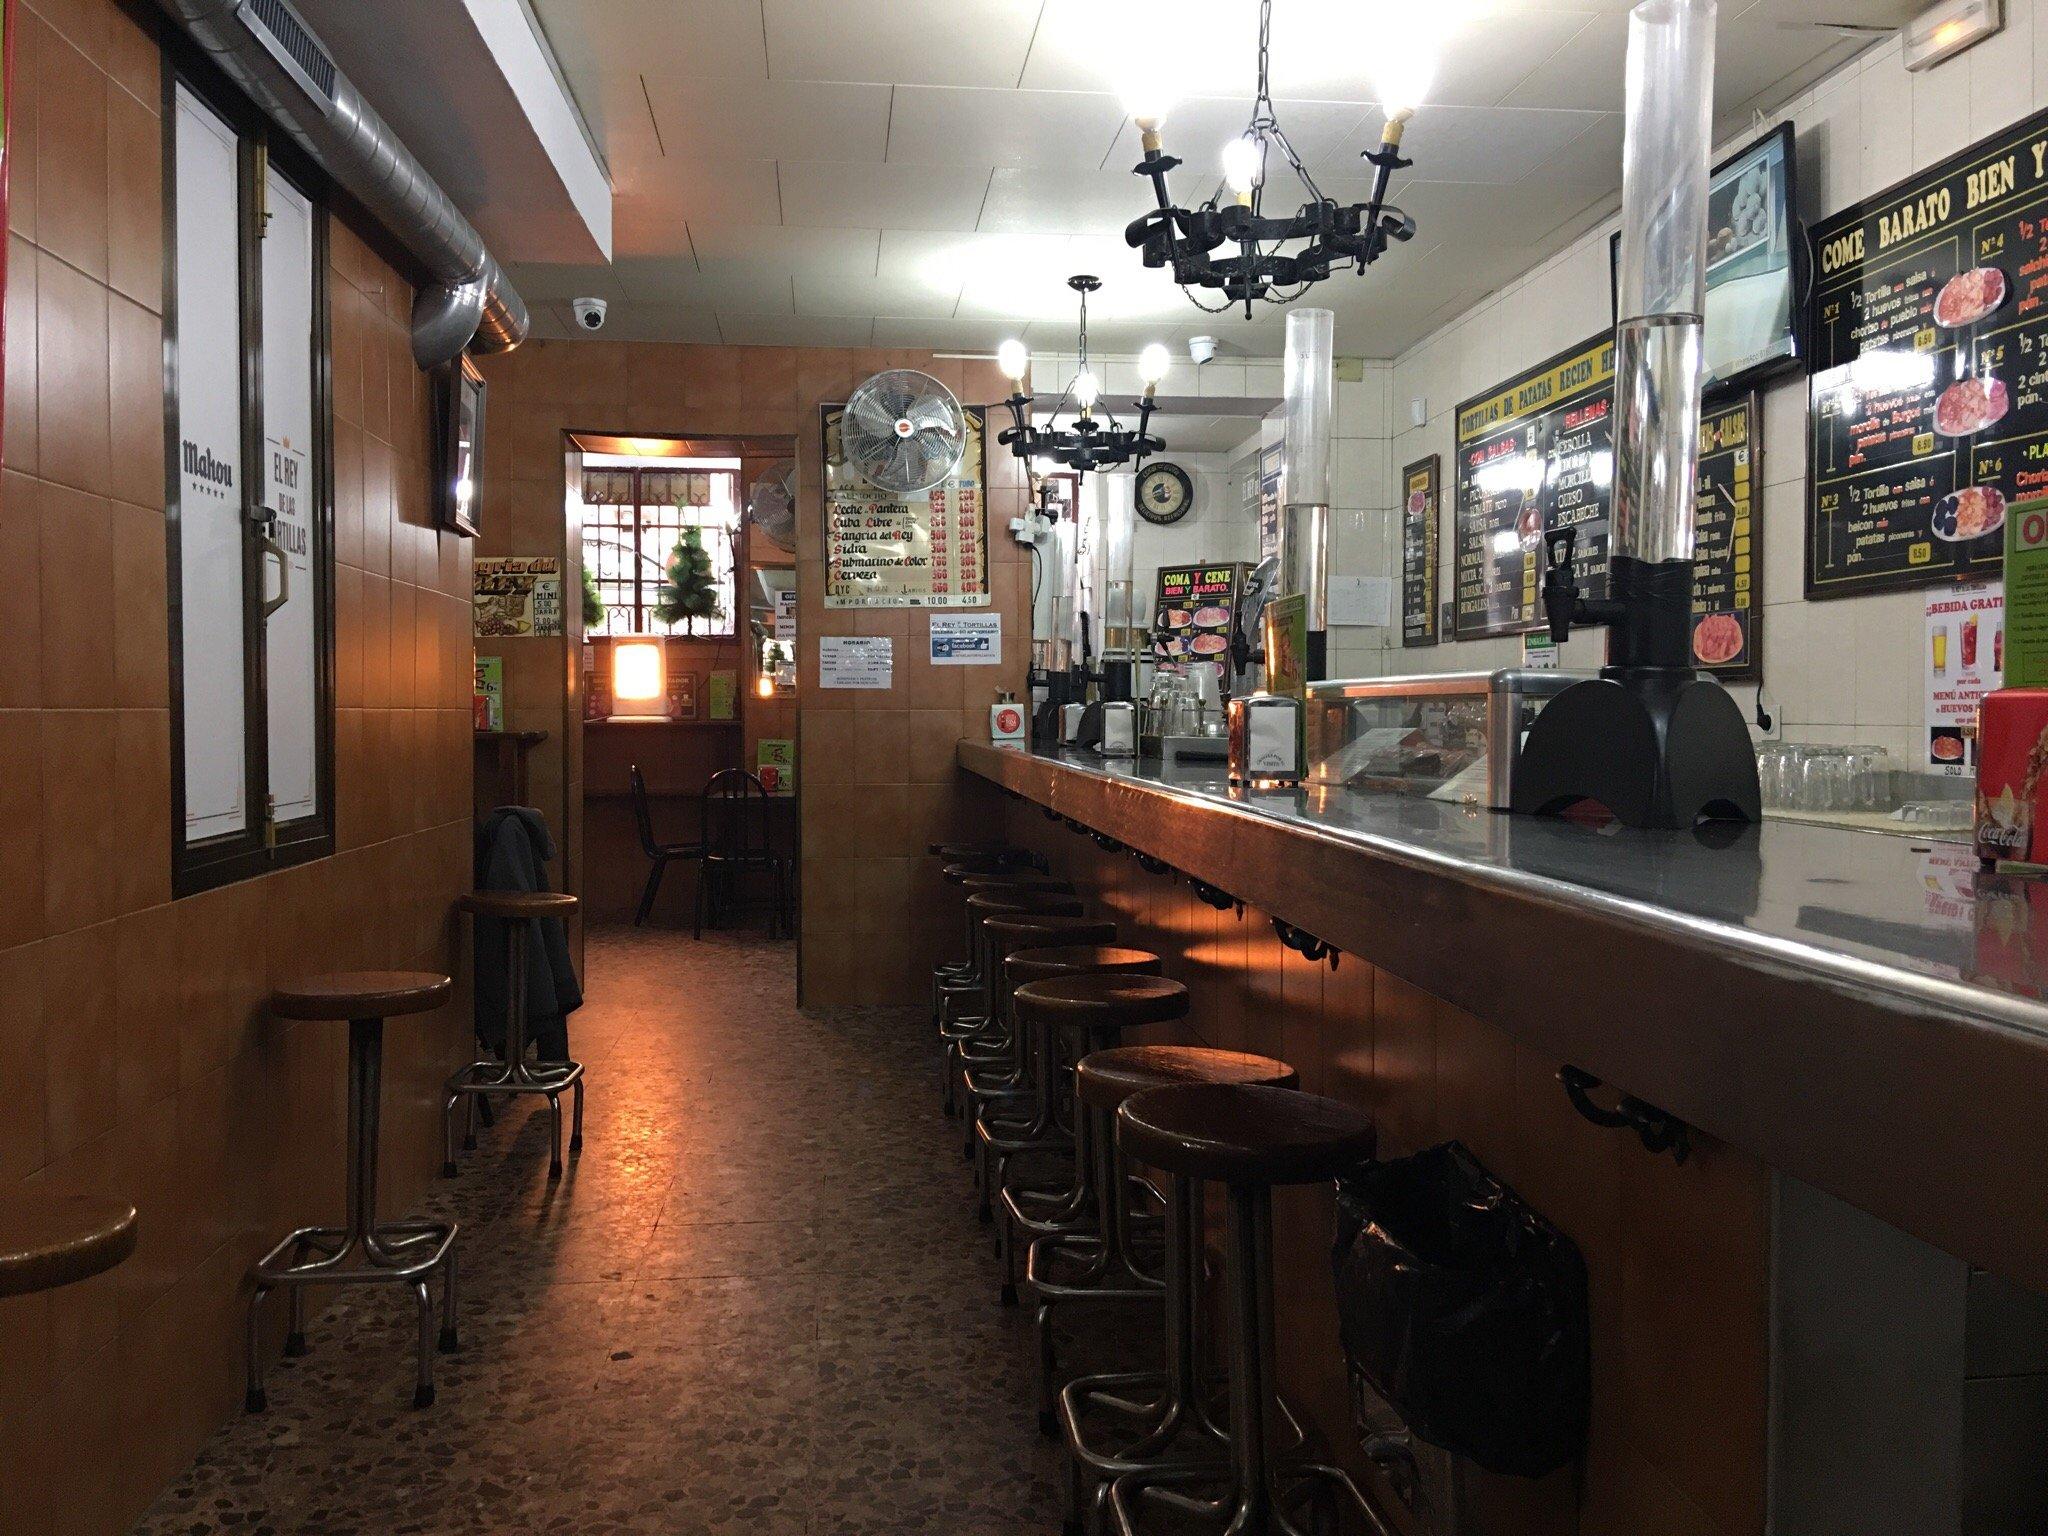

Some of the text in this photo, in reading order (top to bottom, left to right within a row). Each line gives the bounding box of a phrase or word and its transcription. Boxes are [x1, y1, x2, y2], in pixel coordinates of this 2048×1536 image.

[1822, 140, 2048, 273] COME BARATO BIEN Y
[1906, 271, 1927, 288] salsa
[1872, 297, 1901, 317] huevos
[1851, 322, 1879, 339] chorizo
[1890, 306, 1918, 328] pueblo
[2018, 375, 2026, 389] 2
[1462, 402, 1499, 435] TORTILLAS
[1503, 396, 1513, 417] DE
[1519, 377, 1552, 410] PATATAS
[1559, 357, 1593, 392] RECIEN
[1892, 407, 1921, 424] Burgos
[182, 439, 232, 488] Mahou
[274, 452, 298, 490] EL REY
[1863, 484, 1890, 500] Tortilla
[1904, 477, 1926, 492] salsa
[279, 492, 296, 516] DE LAS
[1557, 488, 1583, 509] QUESO
[833, 503, 909, 516] Leche Pantera
[1557, 502, 1600, 527] ESCABECHE
[1862, 503, 1868, 516] 2
[1870, 499, 1898, 514] huevos
[833, 517, 860, 528] Cuba
[866, 517, 892, 528] Libre
[272, 518, 306, 556] RTILLAS
[879, 532, 892, 540] del
[892, 530, 913, 542] Rey
[1856, 533, 1885, 549] patatas
[833, 543, 867, 554] Sidra
[833, 557, 894, 568] Submarino
[904, 555, 928, 567] Color
[1583, 563, 1588, 576] 3
[834, 570, 877, 581] Cerveza
[1164, 571, 1231, 586] COMA Y CENE
[1165, 587, 1184, 595] BIEN
[1184, 586, 1191, 594] Y
[1957, 676, 1981, 686] por cada
[1933, 689, 1956, 701] MENÚ
[1941, 705, 1973, 714] HUEVOS
